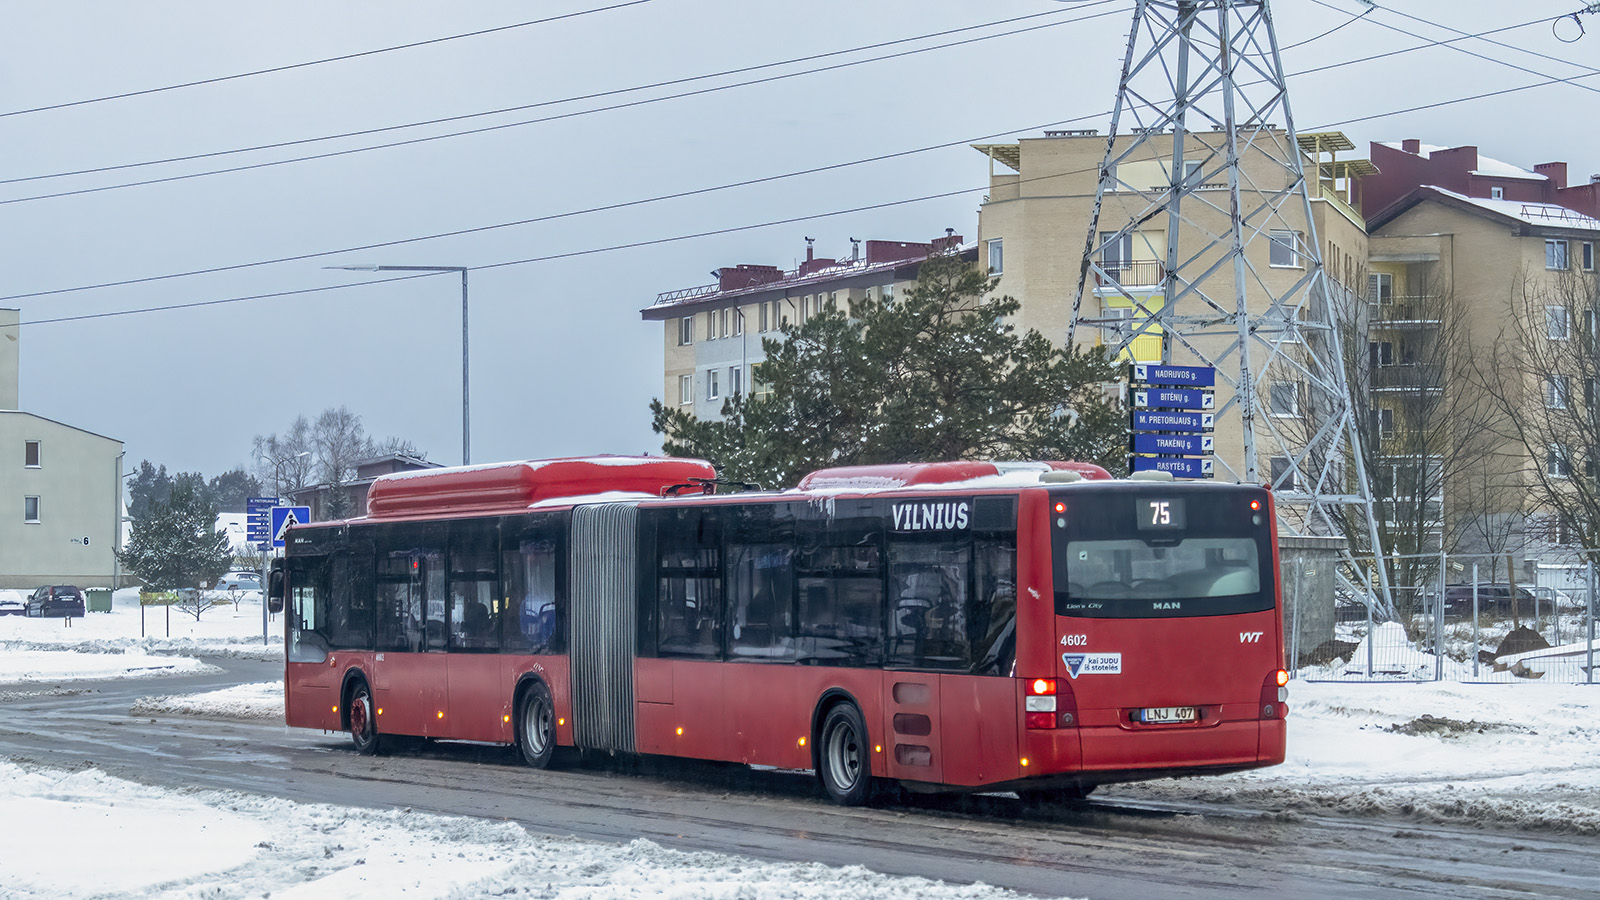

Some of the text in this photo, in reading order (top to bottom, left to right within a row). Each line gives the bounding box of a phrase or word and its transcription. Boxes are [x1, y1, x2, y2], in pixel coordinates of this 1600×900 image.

[1155, 370, 1197, 380] NADRUVOS g.
[1160, 392, 1189, 403] BITĖNŲ g.
[1139, 415, 1147, 424] M.
[1148, 415, 1191, 425] PRETORIJAUS
[1156, 438, 1192, 450] TRAKĖNŲ g.
[1157, 461, 1192, 472] RASYTĖS g.
[892, 502, 968, 530] VILNIUS
[1150, 501, 1170, 525] 75
[83, 536, 89, 546] 6
[1088, 602, 1103, 610] City
[1153, 602, 1181, 610] MAN
[1060, 634, 1088, 646] 4602
[1239, 631, 1264, 643] VVT
[1146, 707, 1193, 720] LNJ 407
